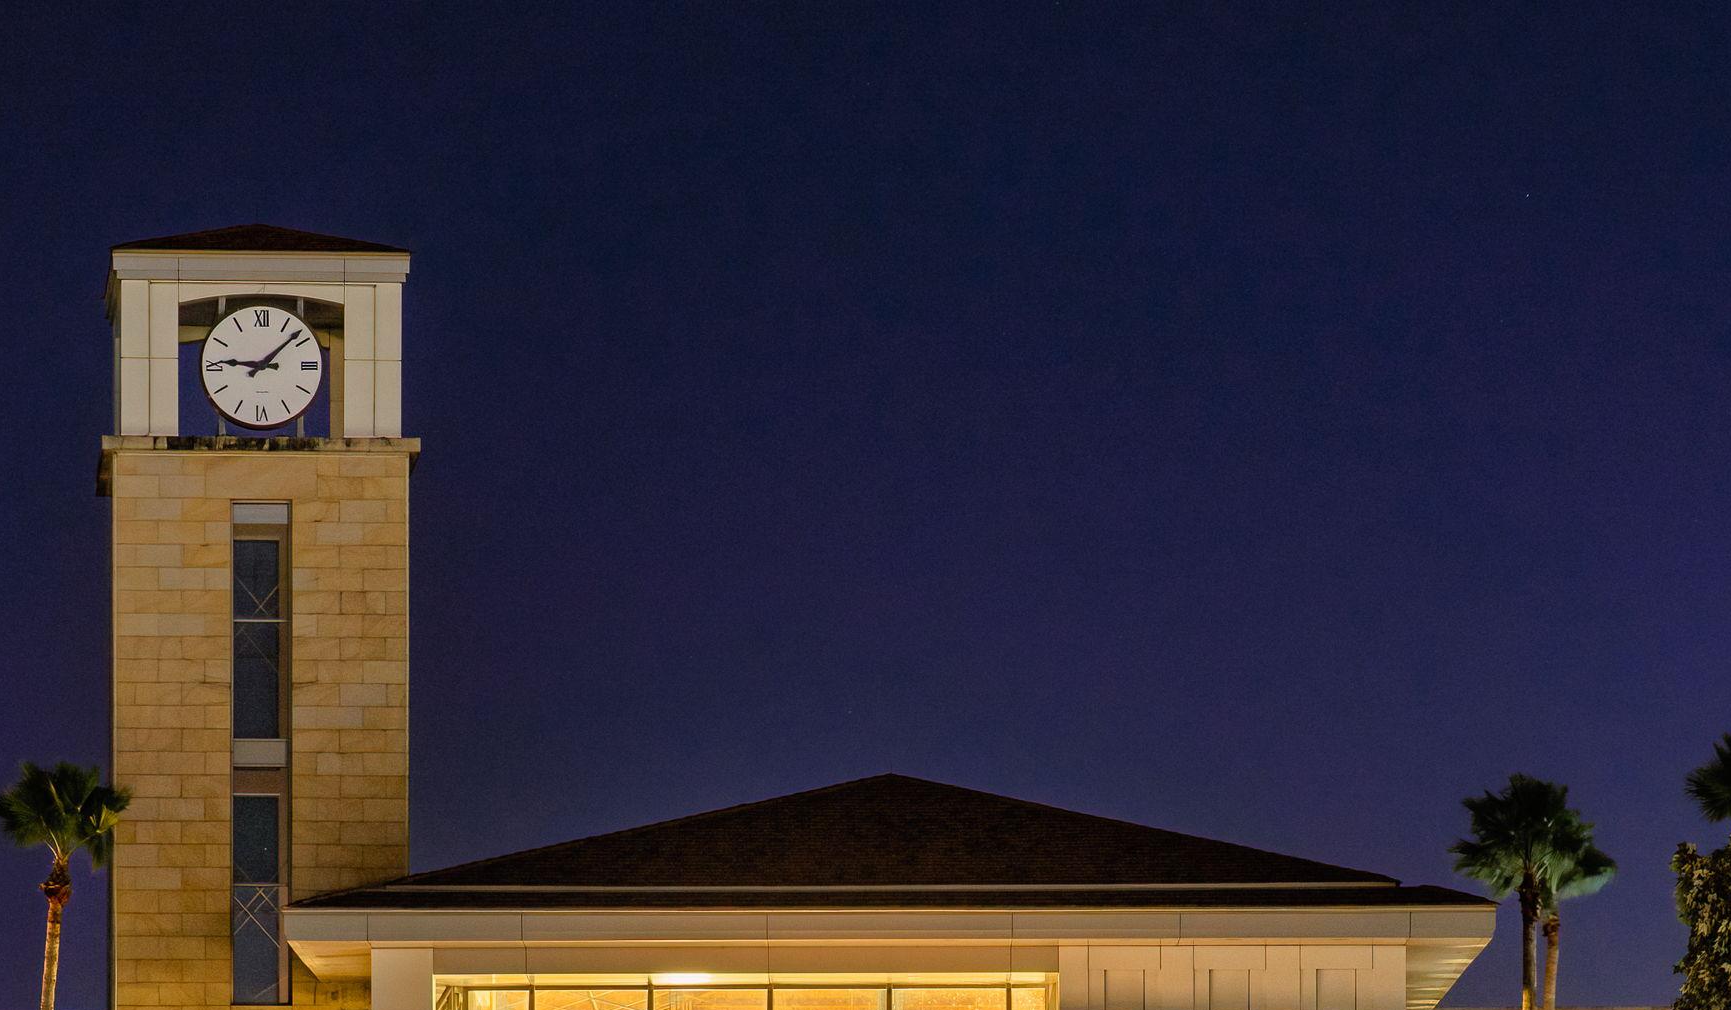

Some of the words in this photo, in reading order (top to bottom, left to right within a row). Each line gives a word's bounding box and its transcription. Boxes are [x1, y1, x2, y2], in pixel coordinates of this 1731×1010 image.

[254, 310, 269, 327] XII
[301, 361, 318, 371] III
[256, 405, 268, 421] VI
